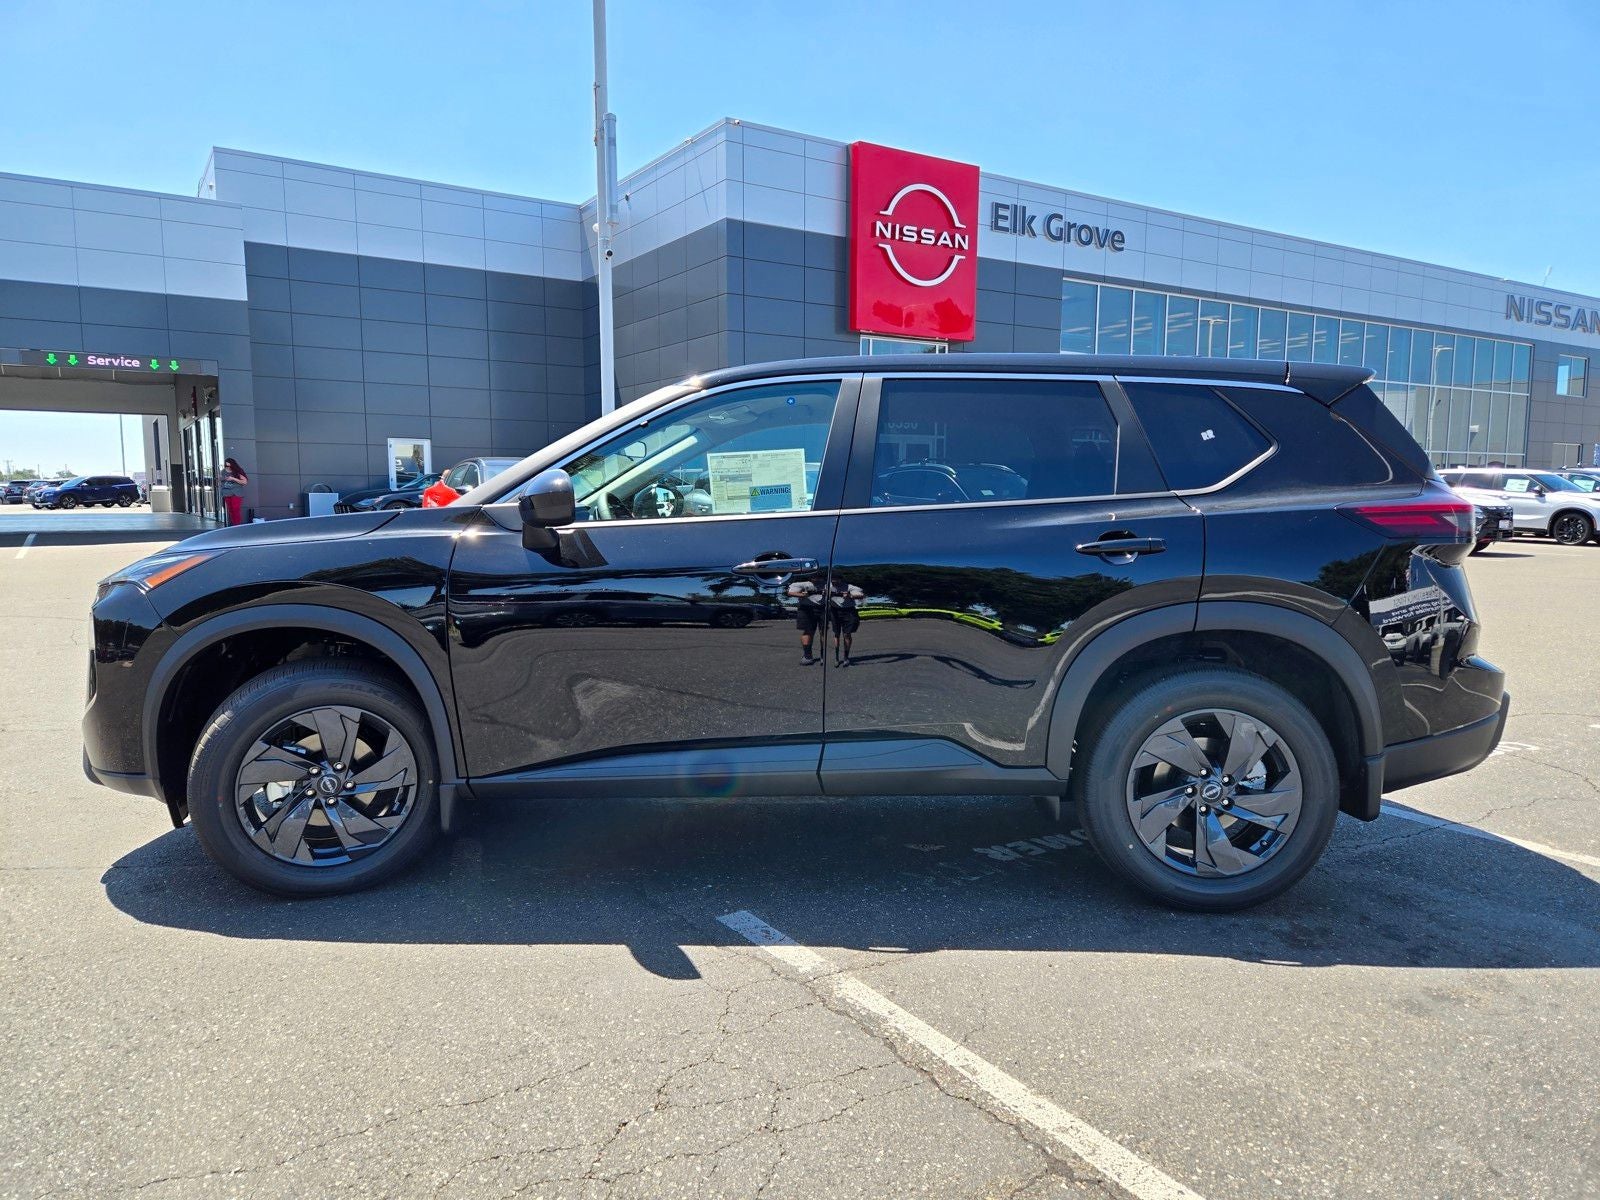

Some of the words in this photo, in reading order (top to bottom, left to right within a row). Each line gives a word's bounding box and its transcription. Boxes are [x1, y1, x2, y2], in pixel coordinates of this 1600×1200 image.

[875, 220, 969, 250] NISSAN
[991, 201, 1037, 237] Elk
[1044, 213, 1126, 252] Grove
[87, 355, 141, 368] Service
